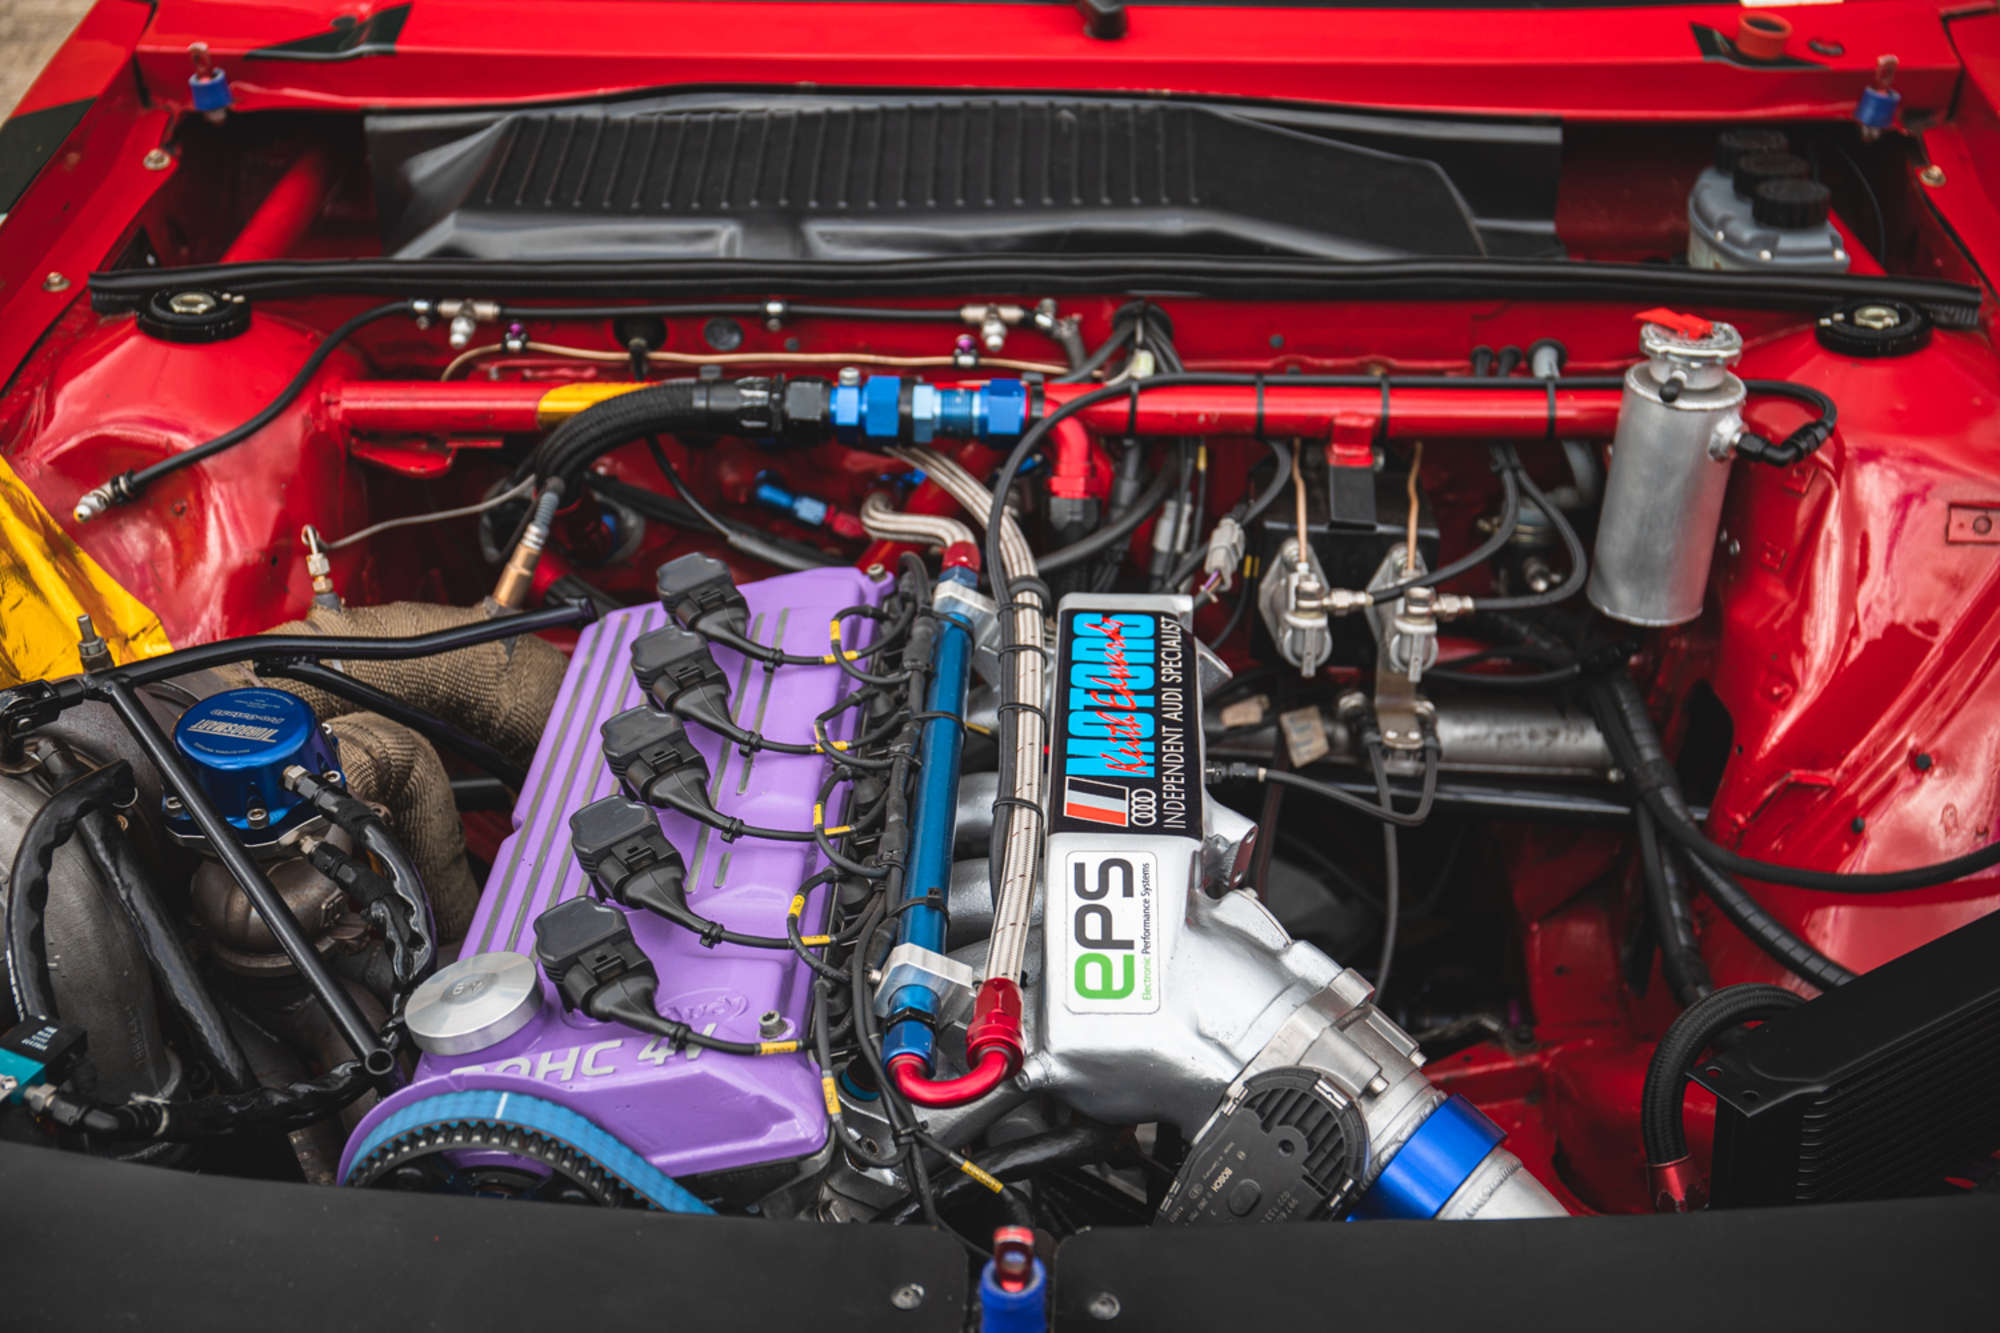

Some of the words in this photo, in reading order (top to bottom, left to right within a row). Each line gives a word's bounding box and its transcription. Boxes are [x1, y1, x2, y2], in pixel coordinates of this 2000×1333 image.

[1085, 616, 1137, 711] Edwards
[1160, 616, 1182, 684] SPECIALIST
[1066, 613, 1155, 778] MOTORS
[1162, 684, 1184, 722] AUDI
[1096, 711, 1148, 775] Keith
[1163, 726, 1187, 829] INDEPENDENT
[1141, 863, 1152, 897] Systems
[1141, 898, 1150, 955] Performance
[1142, 957, 1152, 1001] Electronic
[451, 1039, 623, 1081] OHC
